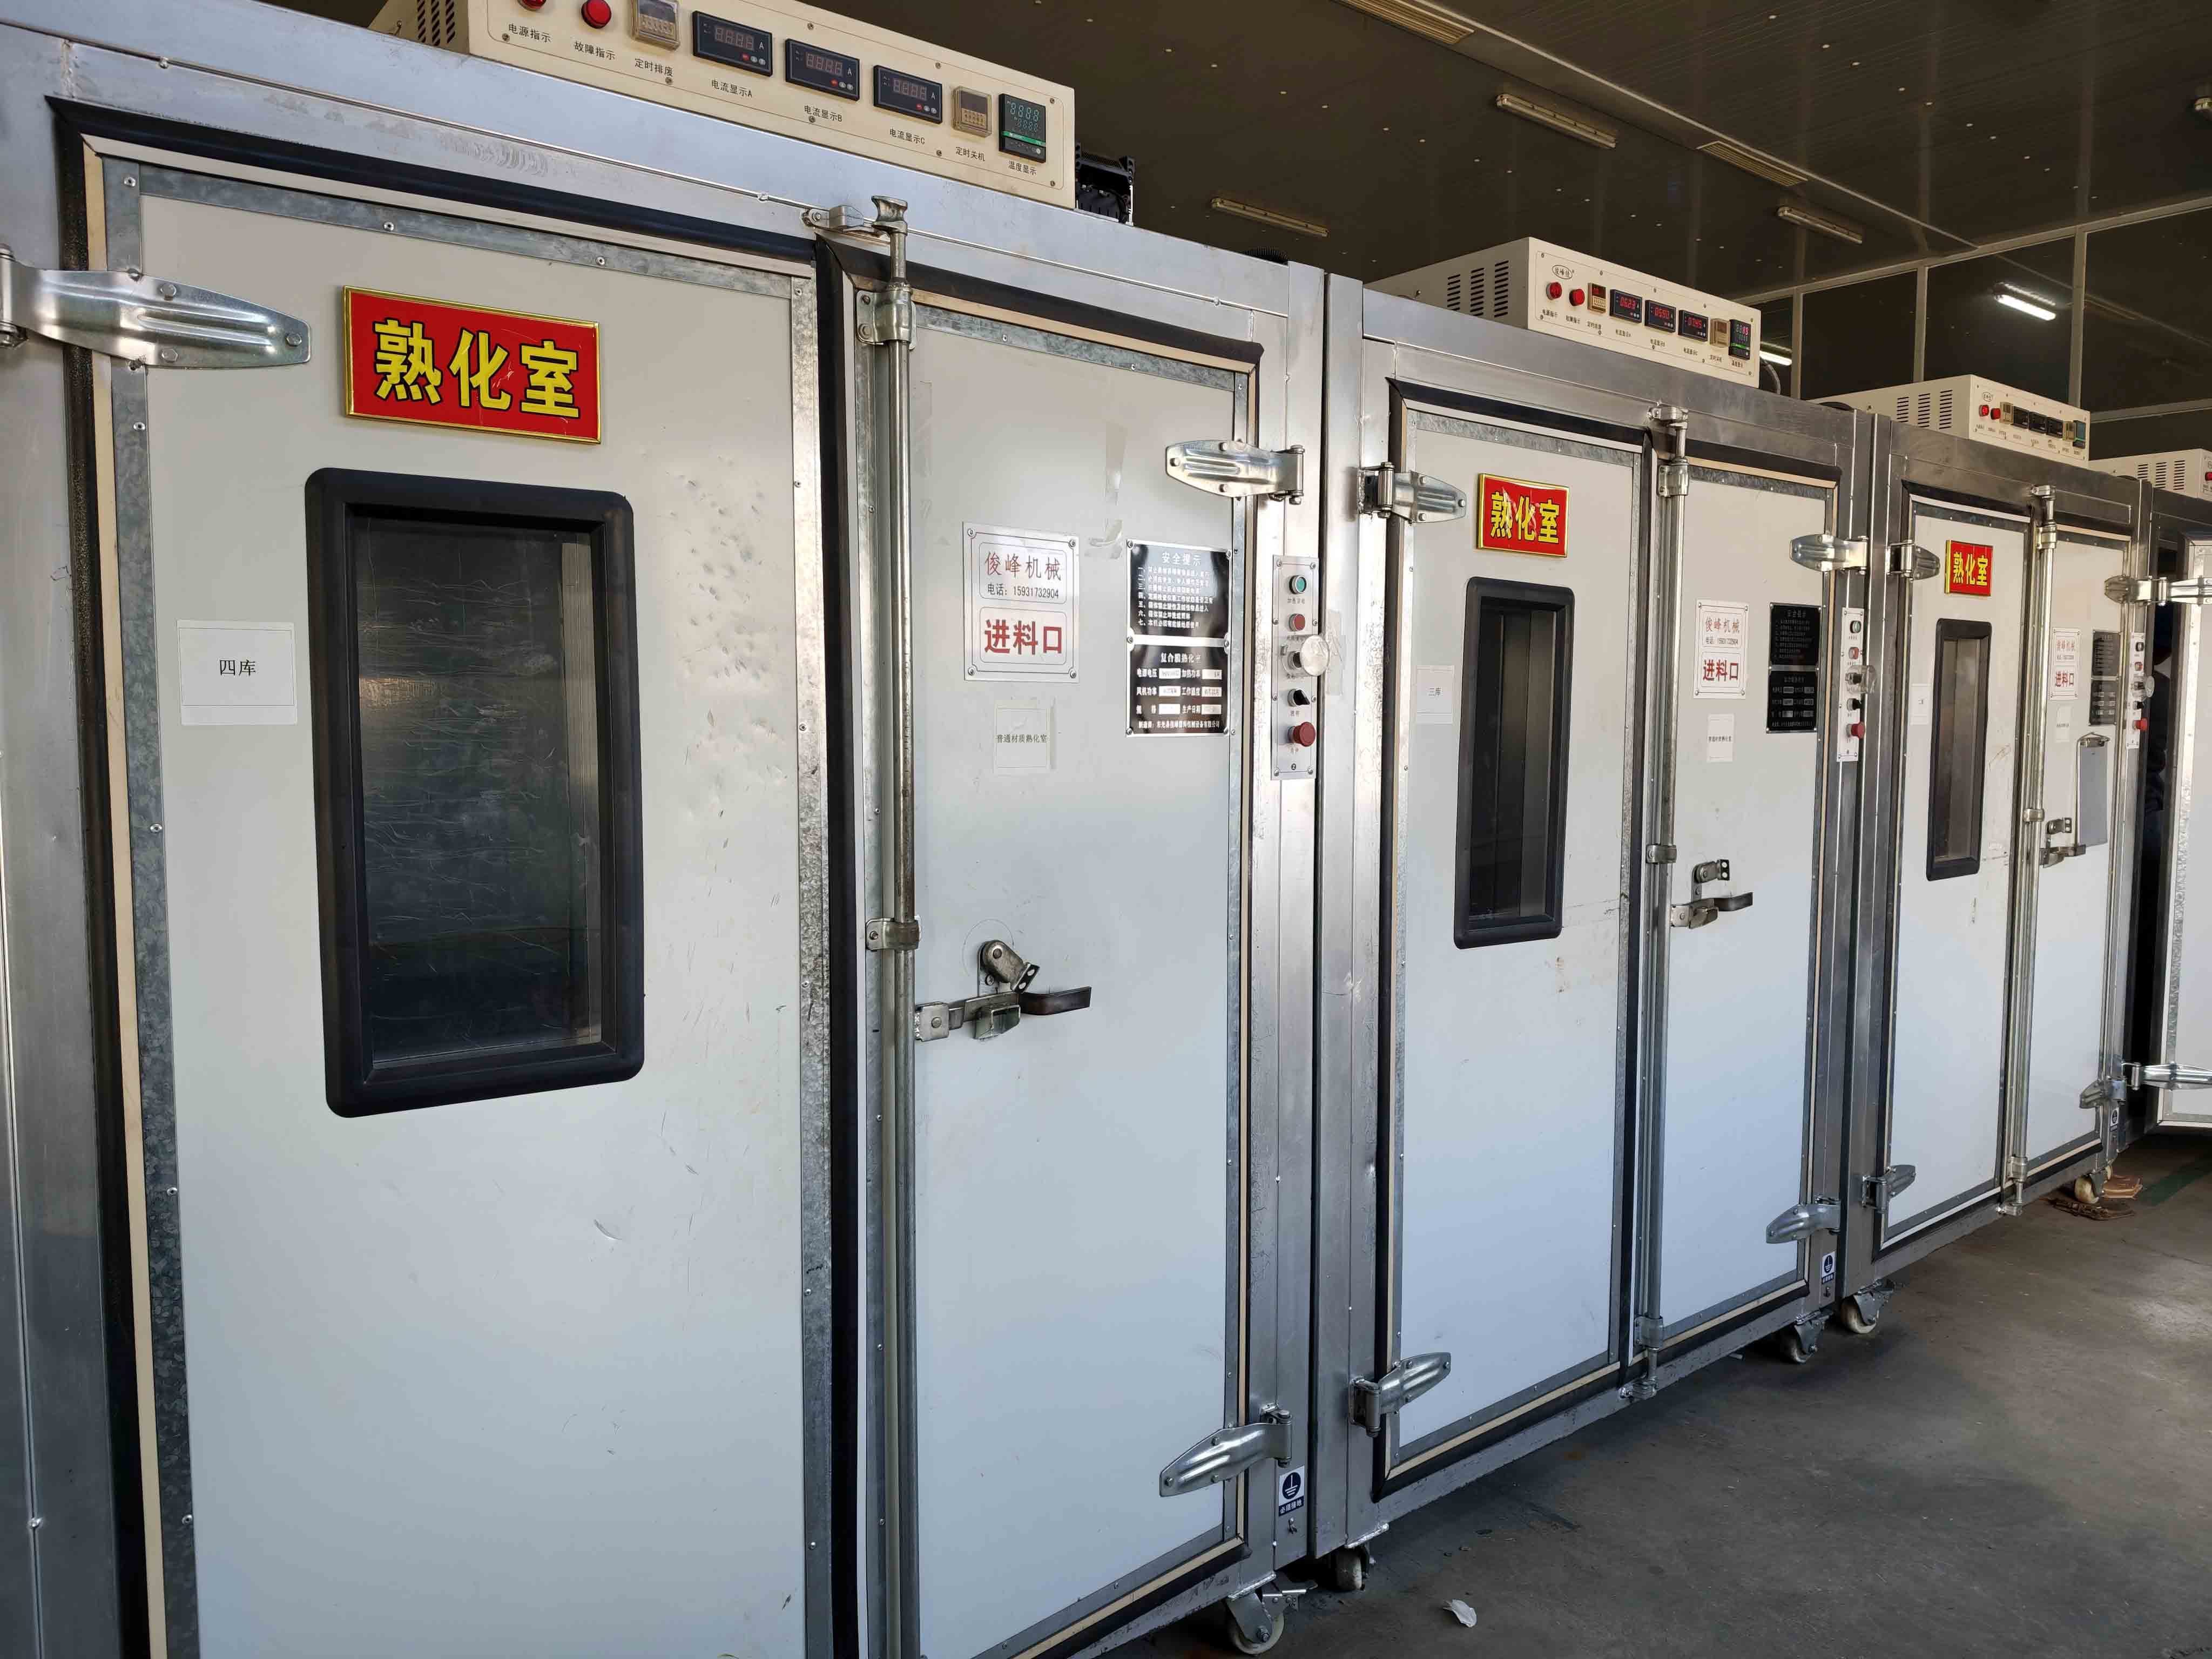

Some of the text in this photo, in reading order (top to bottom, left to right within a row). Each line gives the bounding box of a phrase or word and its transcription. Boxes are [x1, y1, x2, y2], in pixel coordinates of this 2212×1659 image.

[508, 23, 551, 43] 电源指示
[574, 41, 616, 60] 故障指示
[634, 58, 675, 77] 定时排废
[711, 79, 753, 98] 电流显示A
[804, 104, 842, 123] 电流显示B
[889, 128, 925, 145] 电流显示C
[955, 146, 986, 162] 定时关机
[1008, 160, 1037, 176] 温度显示
[373, 319, 581, 419] 熟化室
[1491, 491, 1560, 543] 熟化室
[984, 551, 1061, 581] 俊峰机械
[1162, 551, 1202, 567] 安全提示
[1953, 551, 1988, 586] 熟化室
[1014, 586, 1058, 599] 15931732904
[984, 619, 1062, 655] 进料口
[220, 659, 256, 676] 四库
[1703, 659, 1738, 682] 进料口
[996, 734, 1047, 743] 普通材质熟化室
